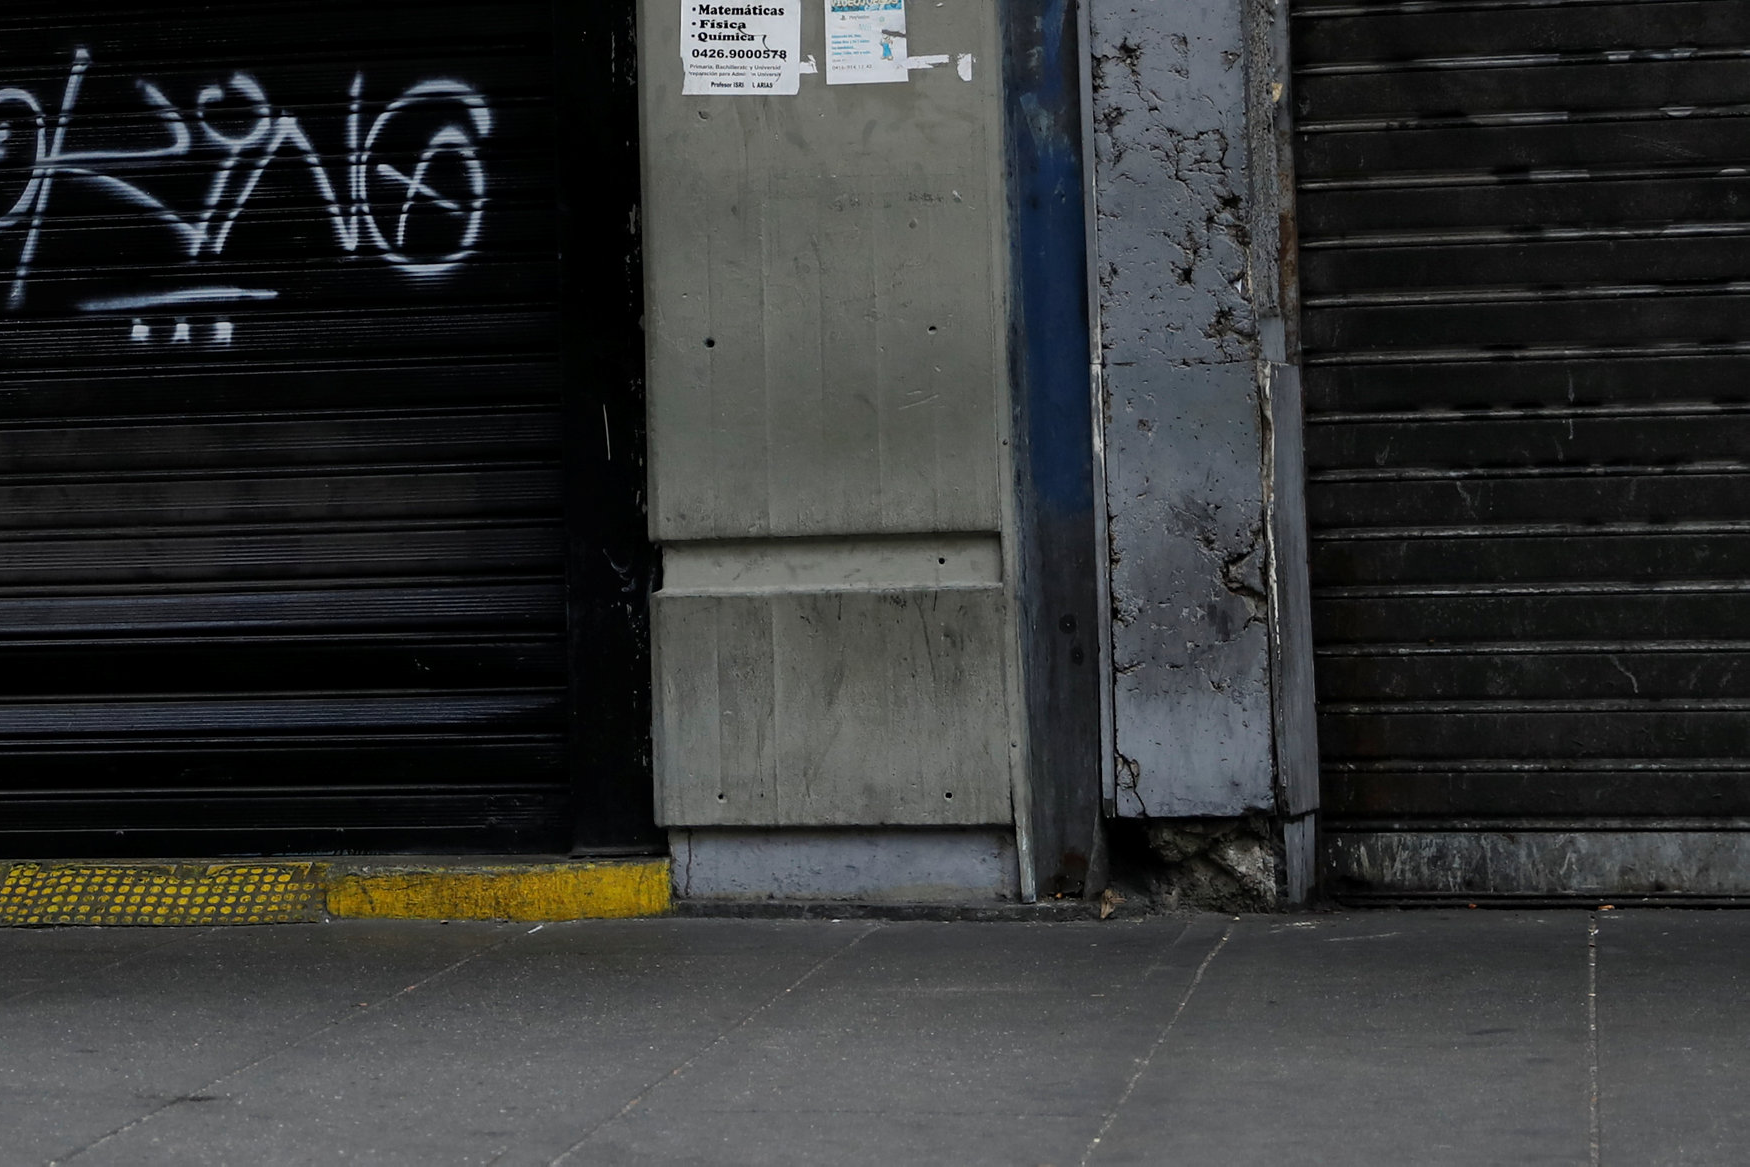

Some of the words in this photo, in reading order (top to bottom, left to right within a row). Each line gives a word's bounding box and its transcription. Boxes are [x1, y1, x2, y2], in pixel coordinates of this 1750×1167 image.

[699, 4, 785, 16] Matemáticas
[699, 19, 747, 29] Física
[698, 32, 755, 42] Química
[691, 49, 787, 59] 0426.9000578
